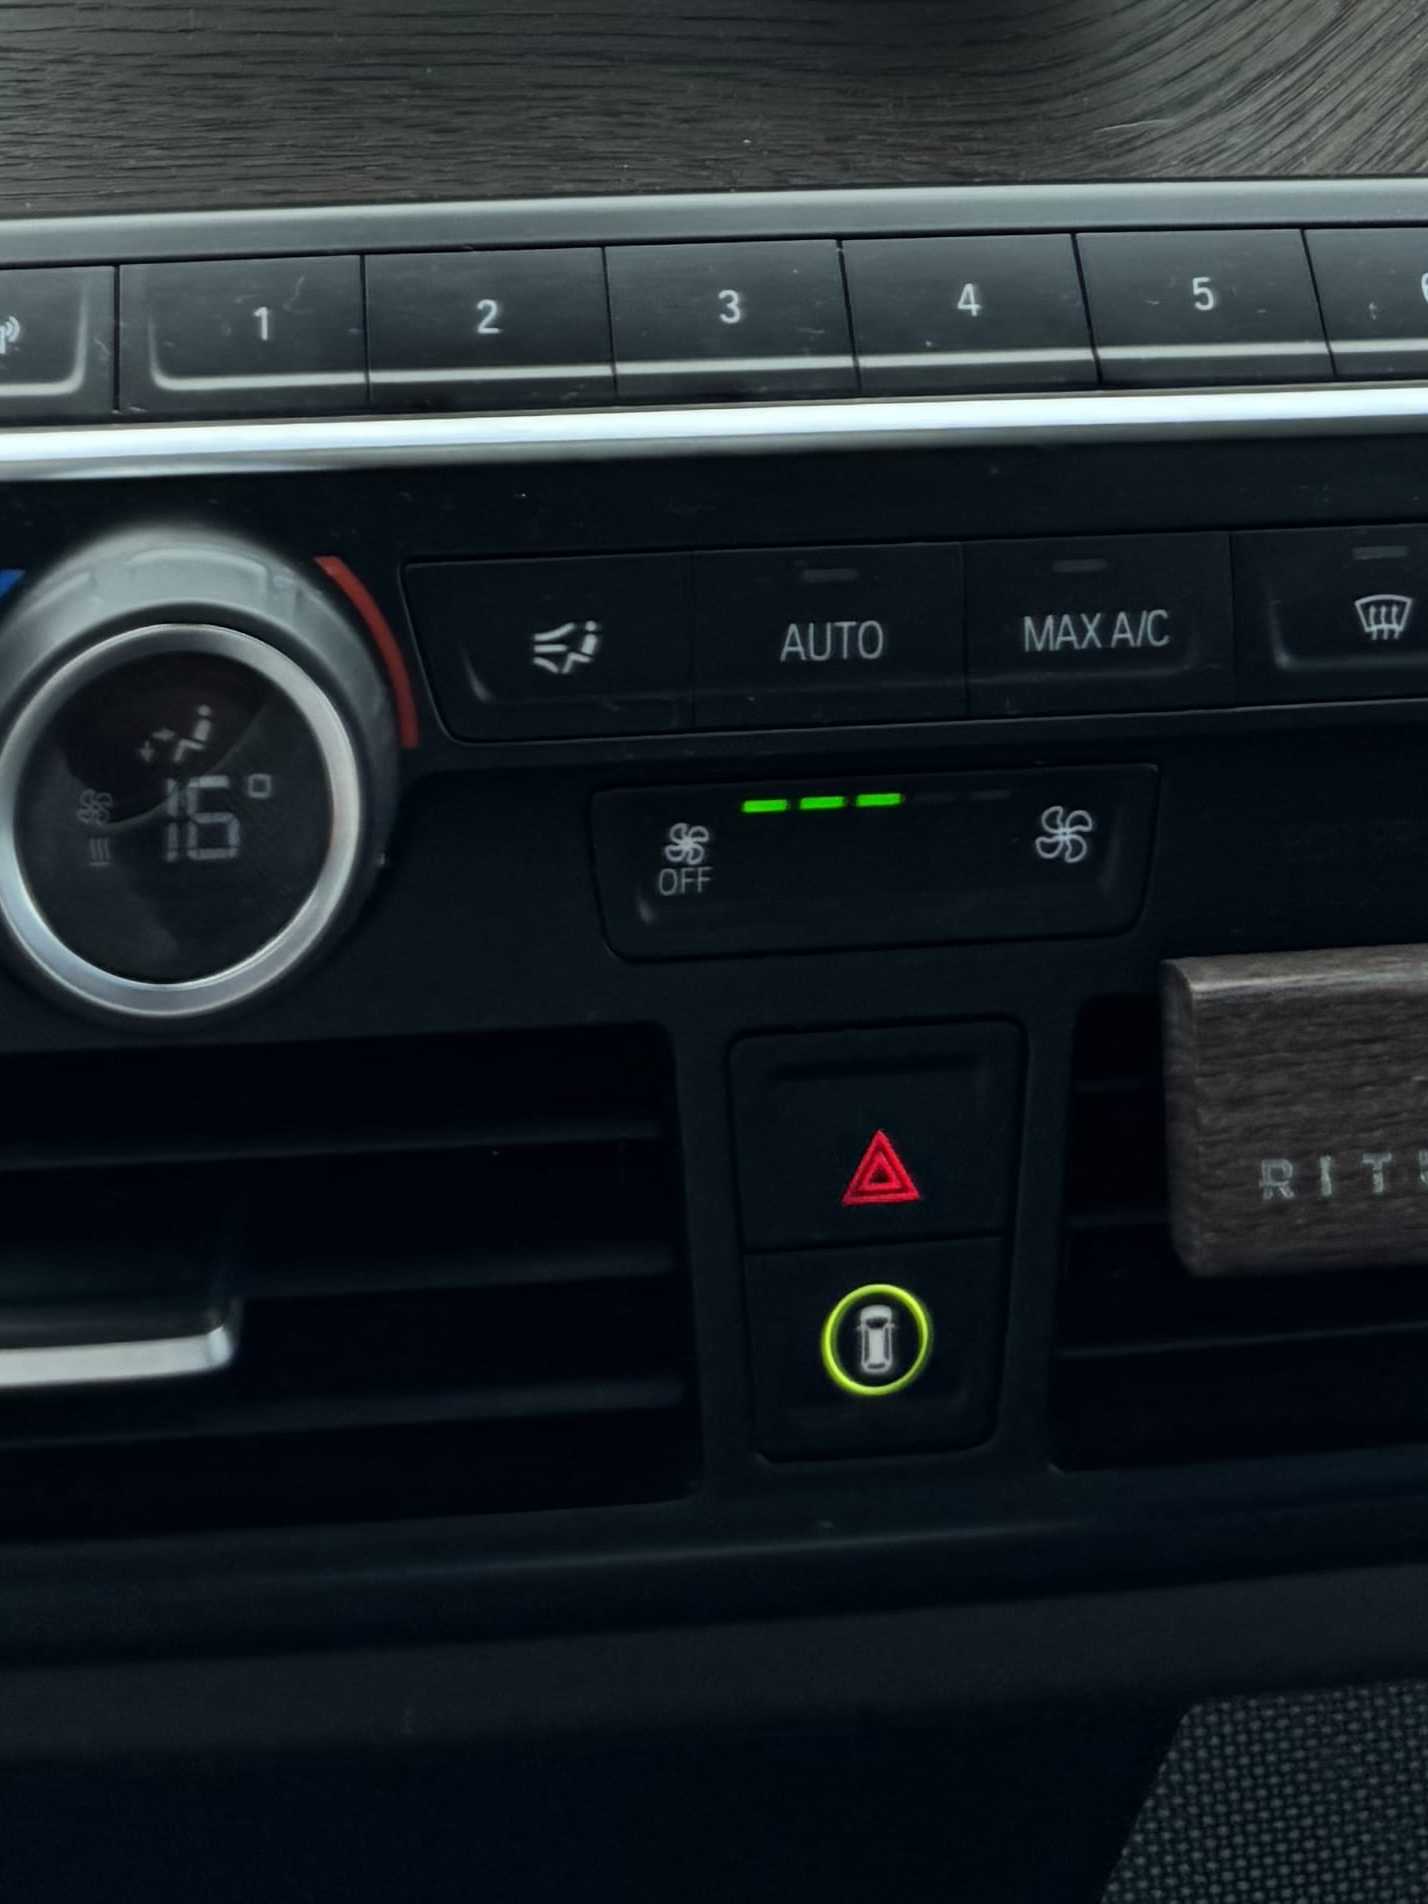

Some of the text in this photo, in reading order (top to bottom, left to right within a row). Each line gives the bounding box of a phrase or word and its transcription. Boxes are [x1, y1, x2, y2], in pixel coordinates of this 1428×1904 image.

[718, 289, 742, 324] 3
[957, 282, 981, 317] 4
[1192, 276, 1215, 311] 5
[253, 306, 269, 341] 1
[476, 298, 500, 335] 2
[780, 620, 884, 661] AUTO
[1024, 609, 1169, 651] MAX A/C
[658, 866, 710, 896] OFF
